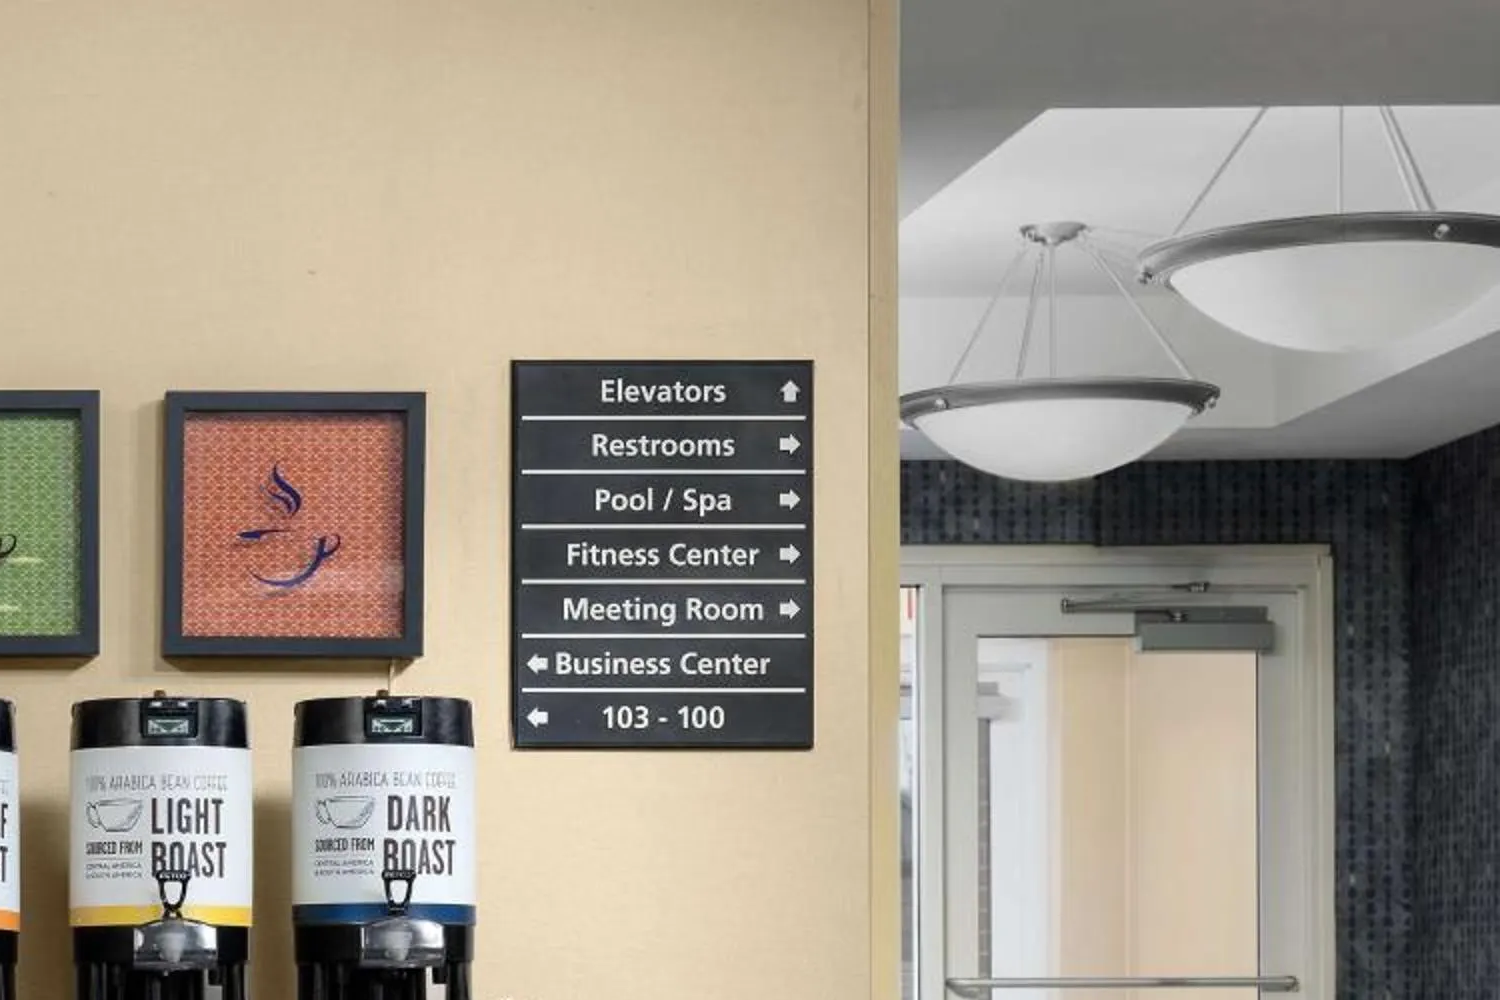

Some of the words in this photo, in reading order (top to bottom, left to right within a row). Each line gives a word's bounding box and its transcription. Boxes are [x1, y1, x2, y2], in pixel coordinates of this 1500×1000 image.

[600, 378, 727, 404] Elevators
[591, 433, 736, 458] Restrooms
[595, 487, 654, 513] Pool
[662, 488, 674, 513] /
[683, 488, 732, 517] Spa
[566, 542, 660, 567] Fitness
[669, 542, 760, 567] Center
[563, 597, 677, 626] Meeting
[686, 597, 764, 621] Room
[555, 652, 671, 676] Business
[680, 652, 771, 676] Center
[602, 706, 650, 730] 103
[678, 706, 726, 730] 100
[151, 798, 224, 835] LIGHT
[387, 795, 451, 832] DARK
[151, 841, 227, 879] ROAST
[383, 838, 457, 876] ROAST
